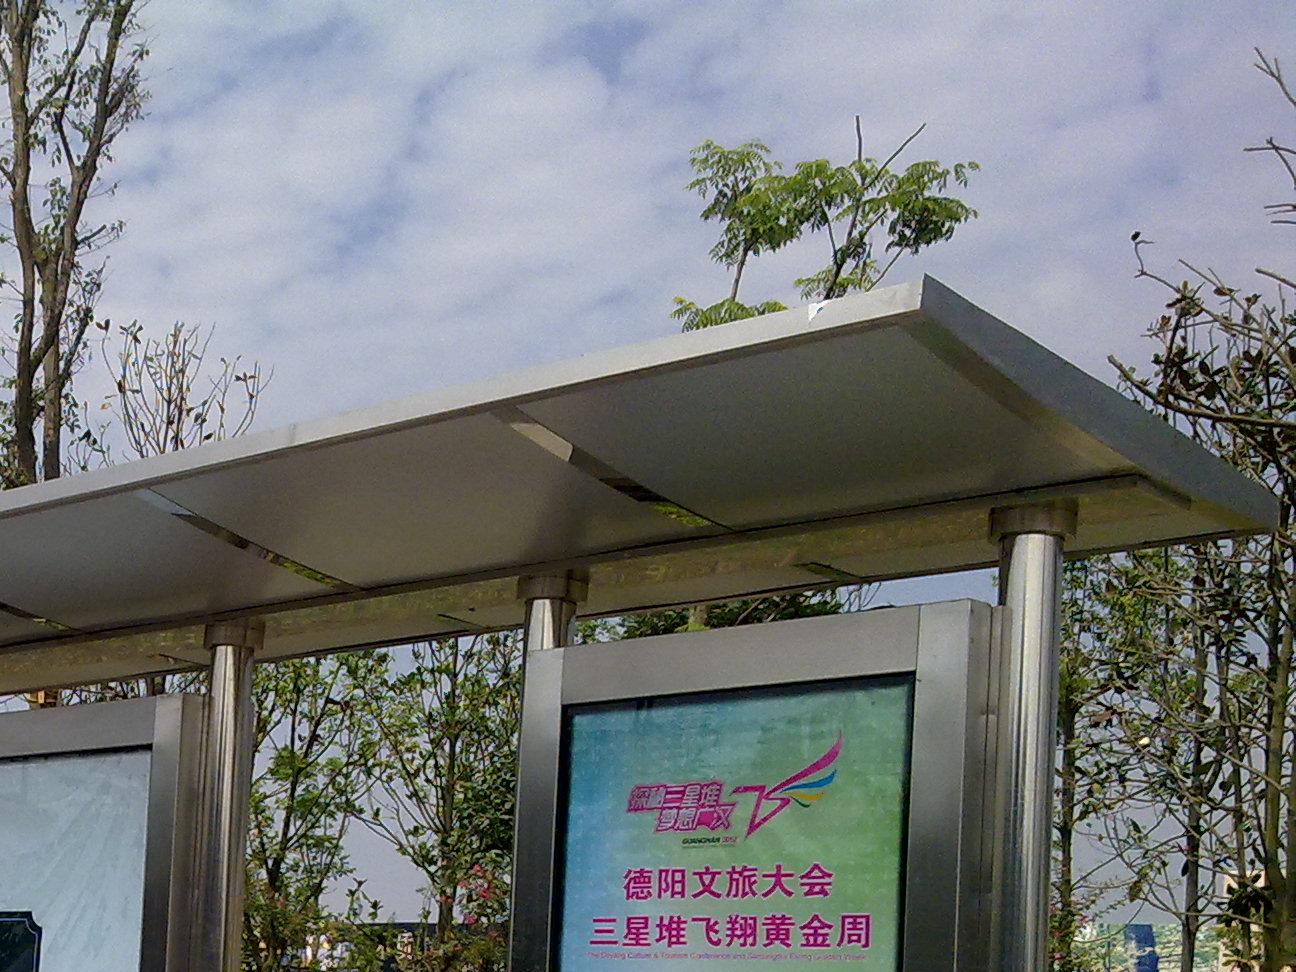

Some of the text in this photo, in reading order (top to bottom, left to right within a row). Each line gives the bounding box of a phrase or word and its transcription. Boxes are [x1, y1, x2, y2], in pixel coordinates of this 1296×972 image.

[623, 863, 833, 900] 德阳文旅大会
[589, 914, 872, 949] 三星堆飞翔黄金周
